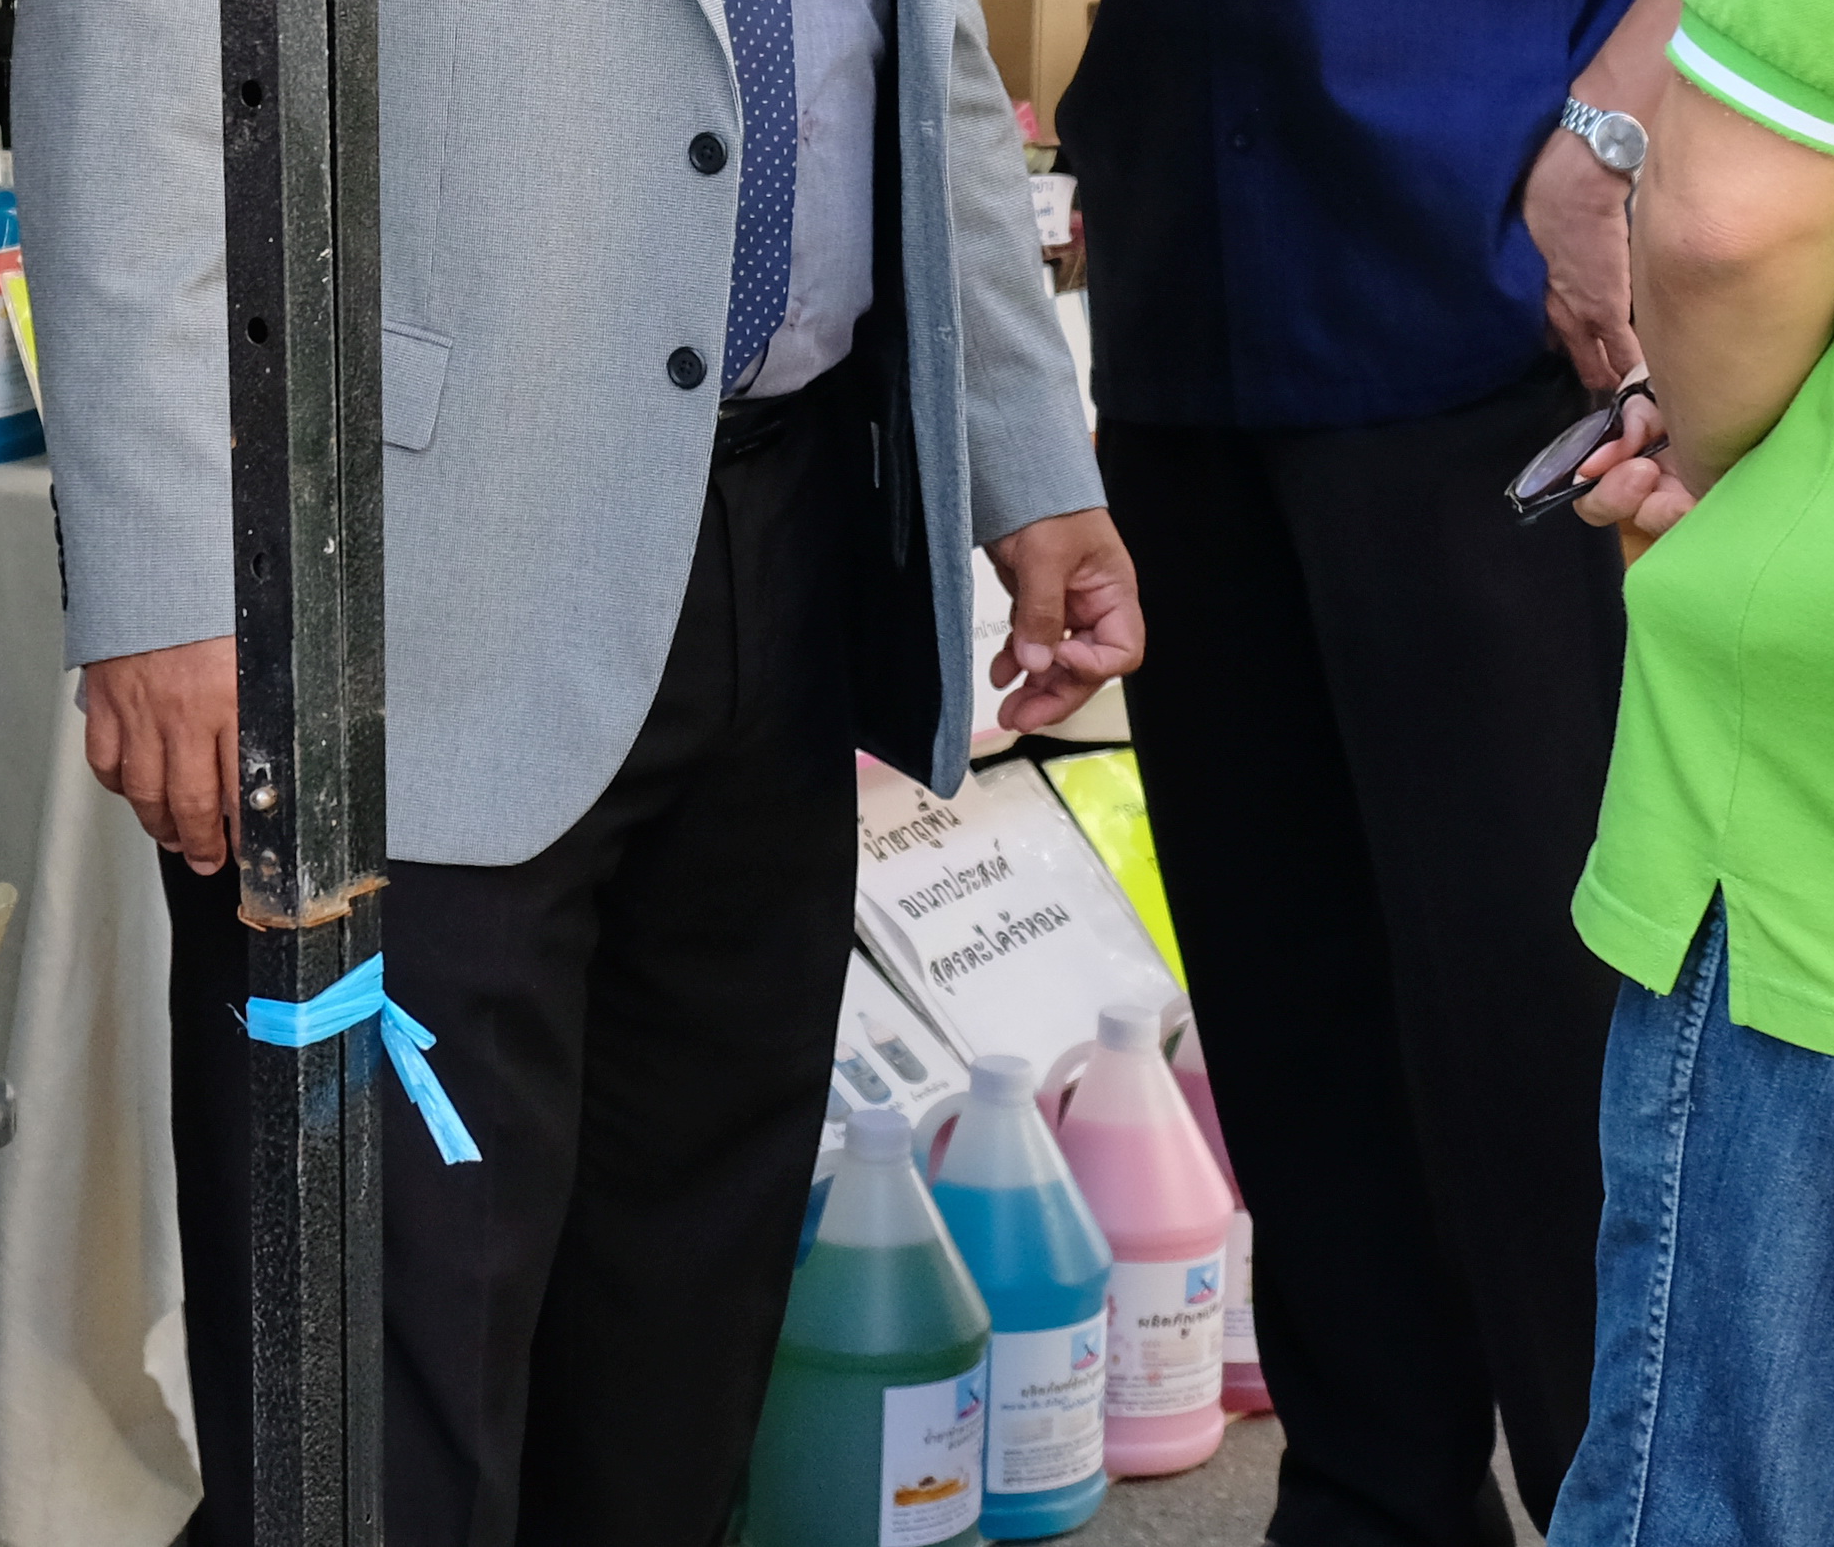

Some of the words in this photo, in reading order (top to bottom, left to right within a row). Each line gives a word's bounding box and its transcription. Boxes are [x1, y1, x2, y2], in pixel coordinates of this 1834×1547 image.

[898, 838, 1014, 920] อเนกประสงค์
[928, 903, 1071, 996] สูตรตะไคร้หอม
